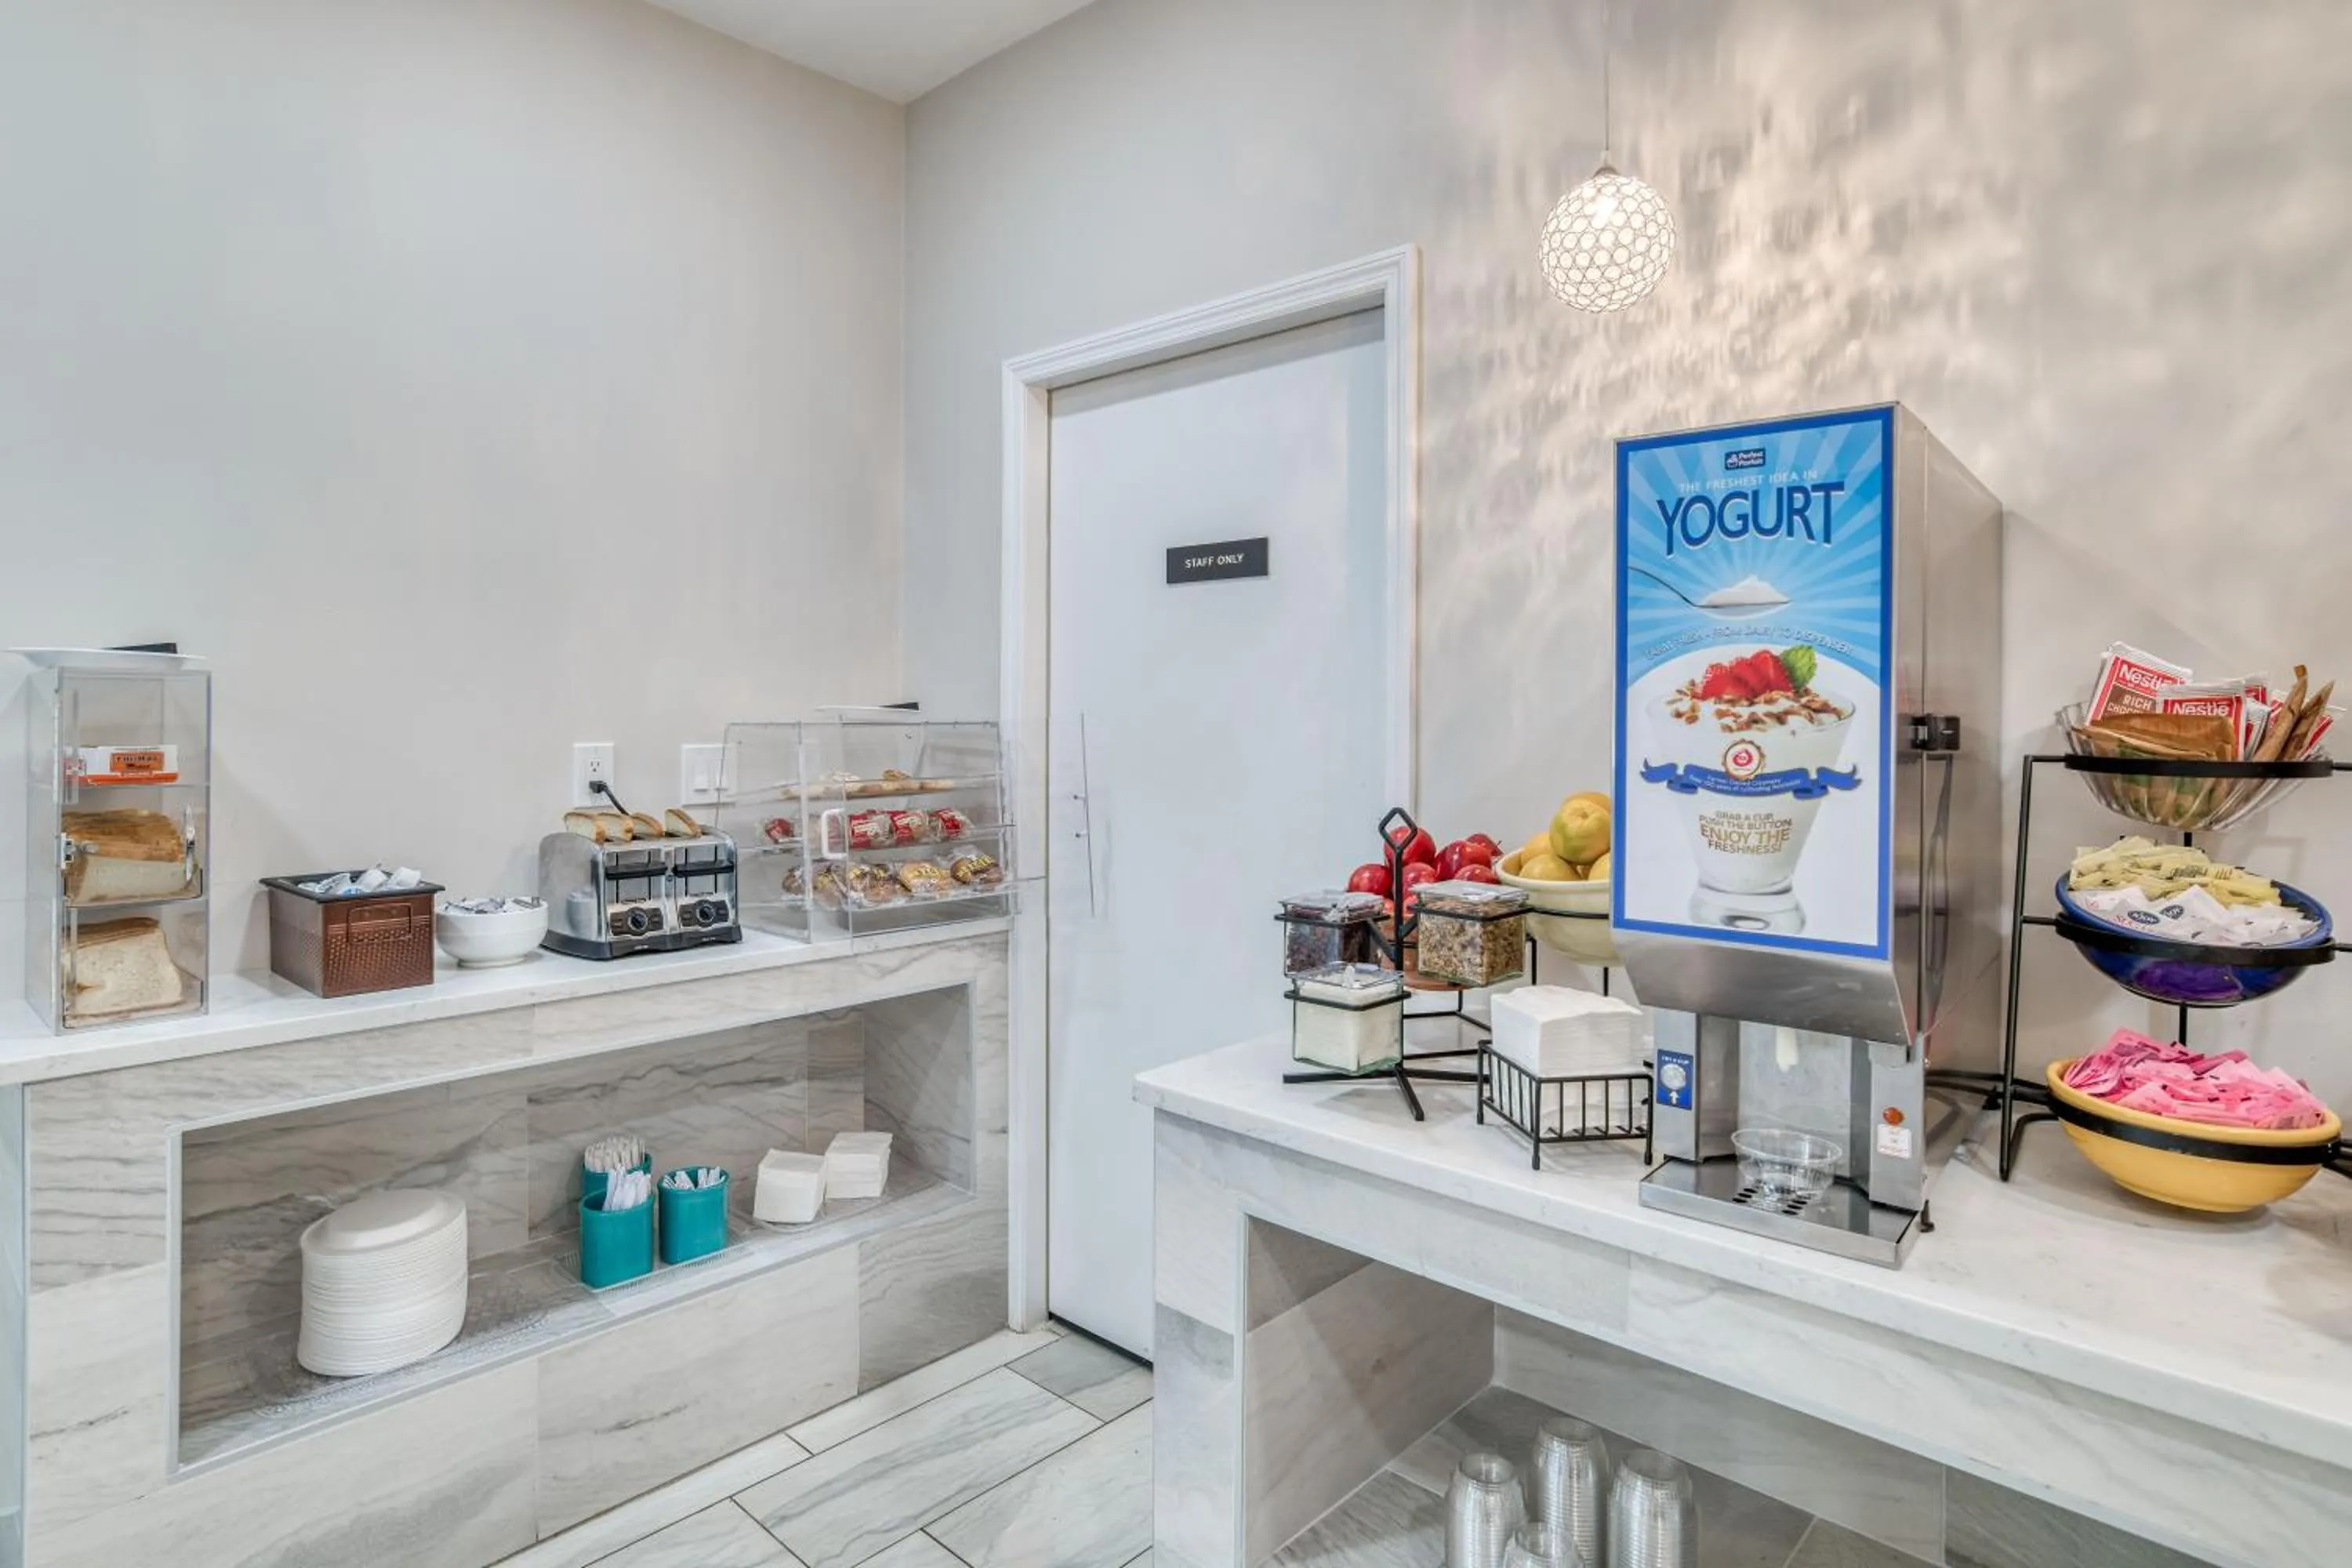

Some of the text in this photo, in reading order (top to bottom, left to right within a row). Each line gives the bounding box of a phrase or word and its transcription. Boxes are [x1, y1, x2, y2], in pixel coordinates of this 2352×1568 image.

[1680, 470, 1818, 493] THE FRESHEST IDEA IN
[1656, 481, 1845, 557] YOGURT
[1185, 554, 1245, 568] STAFF ONLY
[2122, 695, 2152, 710] RICH
[1699, 815, 1724, 827] PUSH
[1727, 820, 1745, 829] THE
[1715, 811, 1741, 821] GRAB
[1700, 824, 1791, 844] ENJOY THE
[1708, 840, 1782, 855] FRESHNESS!
